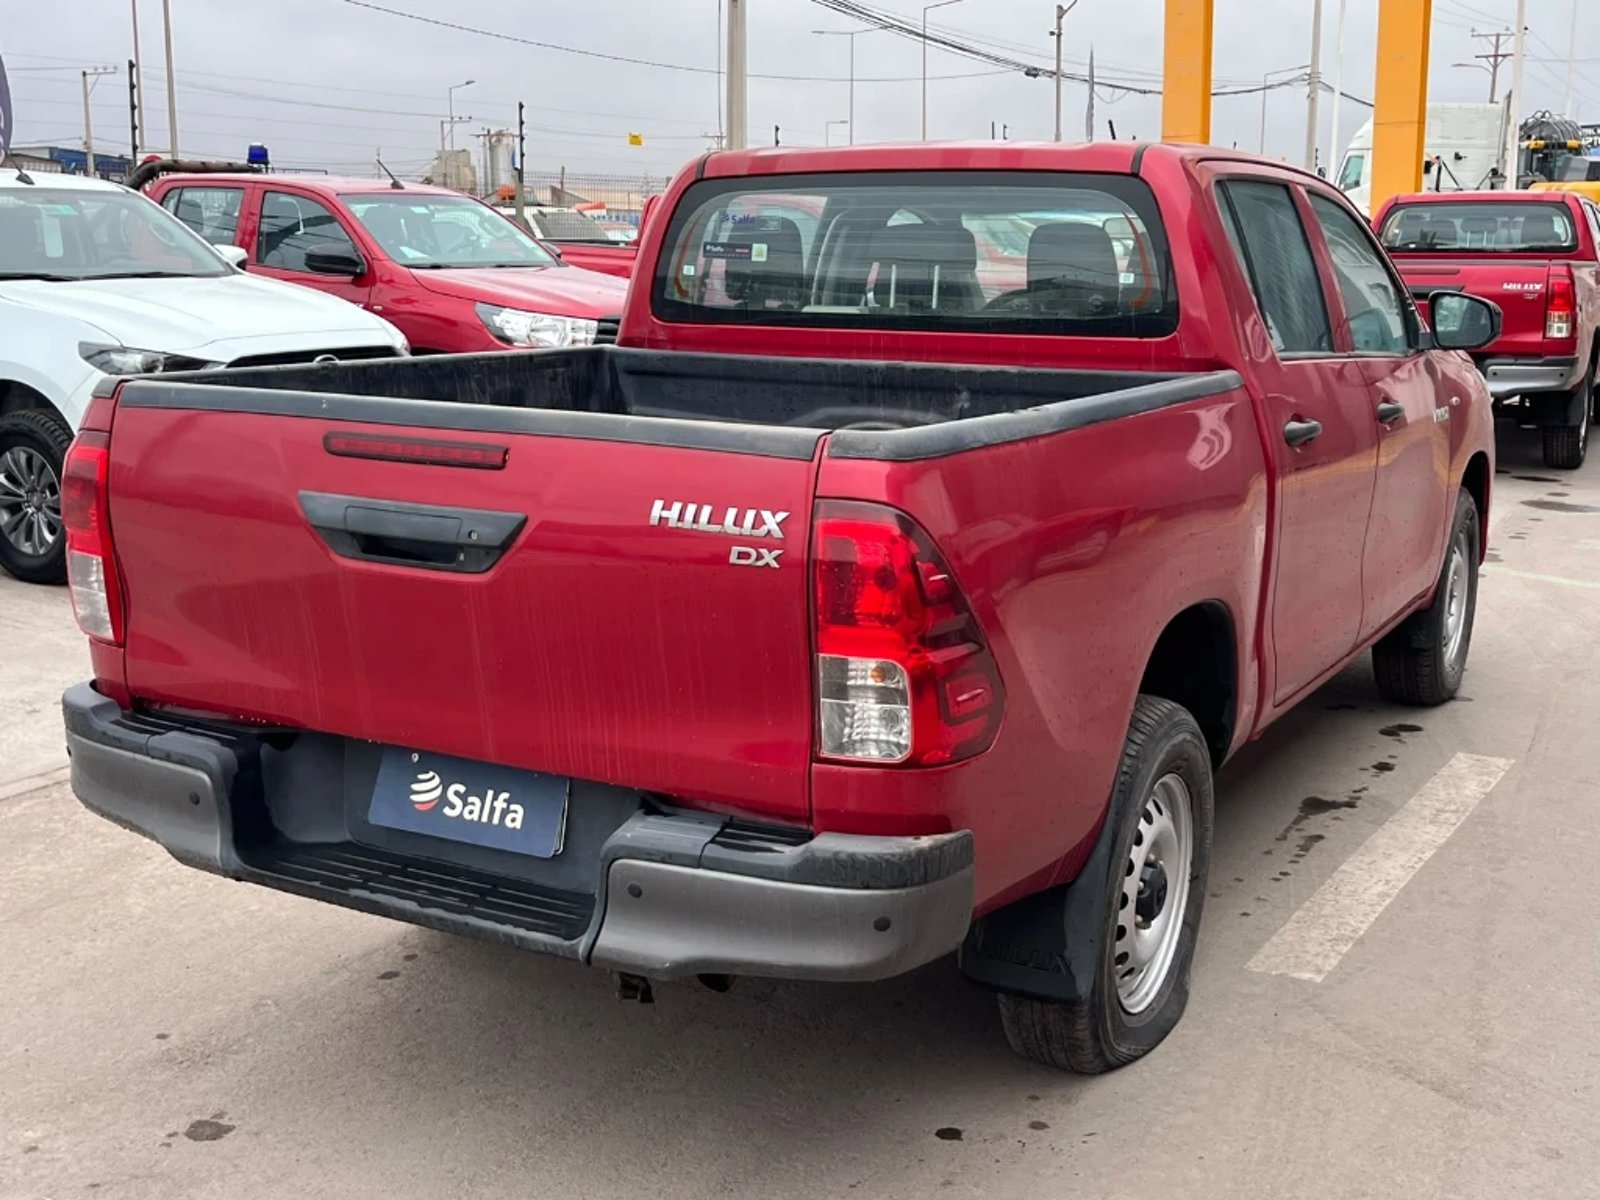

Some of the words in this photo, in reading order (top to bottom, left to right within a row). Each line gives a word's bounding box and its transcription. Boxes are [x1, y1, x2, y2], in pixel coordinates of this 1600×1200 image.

[731, 214, 756, 225] Salfa
[649, 498, 790, 539] HILUX
[729, 546, 784, 568] DX
[443, 783, 525, 830] Salfa
